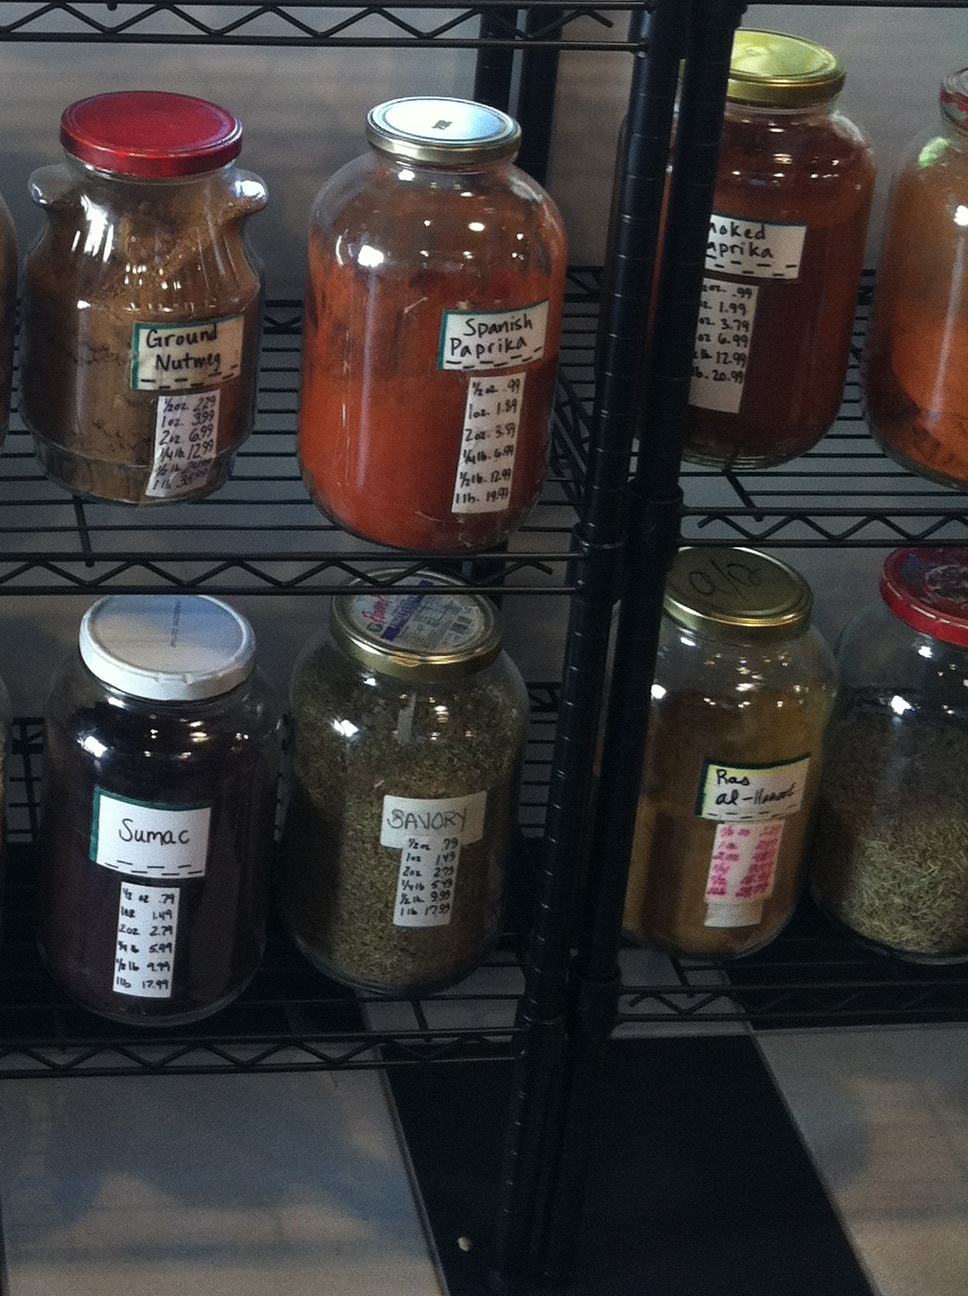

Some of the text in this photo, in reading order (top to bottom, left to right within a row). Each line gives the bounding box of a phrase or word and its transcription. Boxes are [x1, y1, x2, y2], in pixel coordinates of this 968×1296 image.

[146, 324, 217, 348] Ground
[463, 314, 532, 338] Spanish
[450, 336, 527, 356] Paprika
[156, 354, 221, 374] Nutmeg
[716, 769, 750, 785] Ras
[118, 818, 190, 845] Sumac
[387, 808, 467, 832] SAVORY
